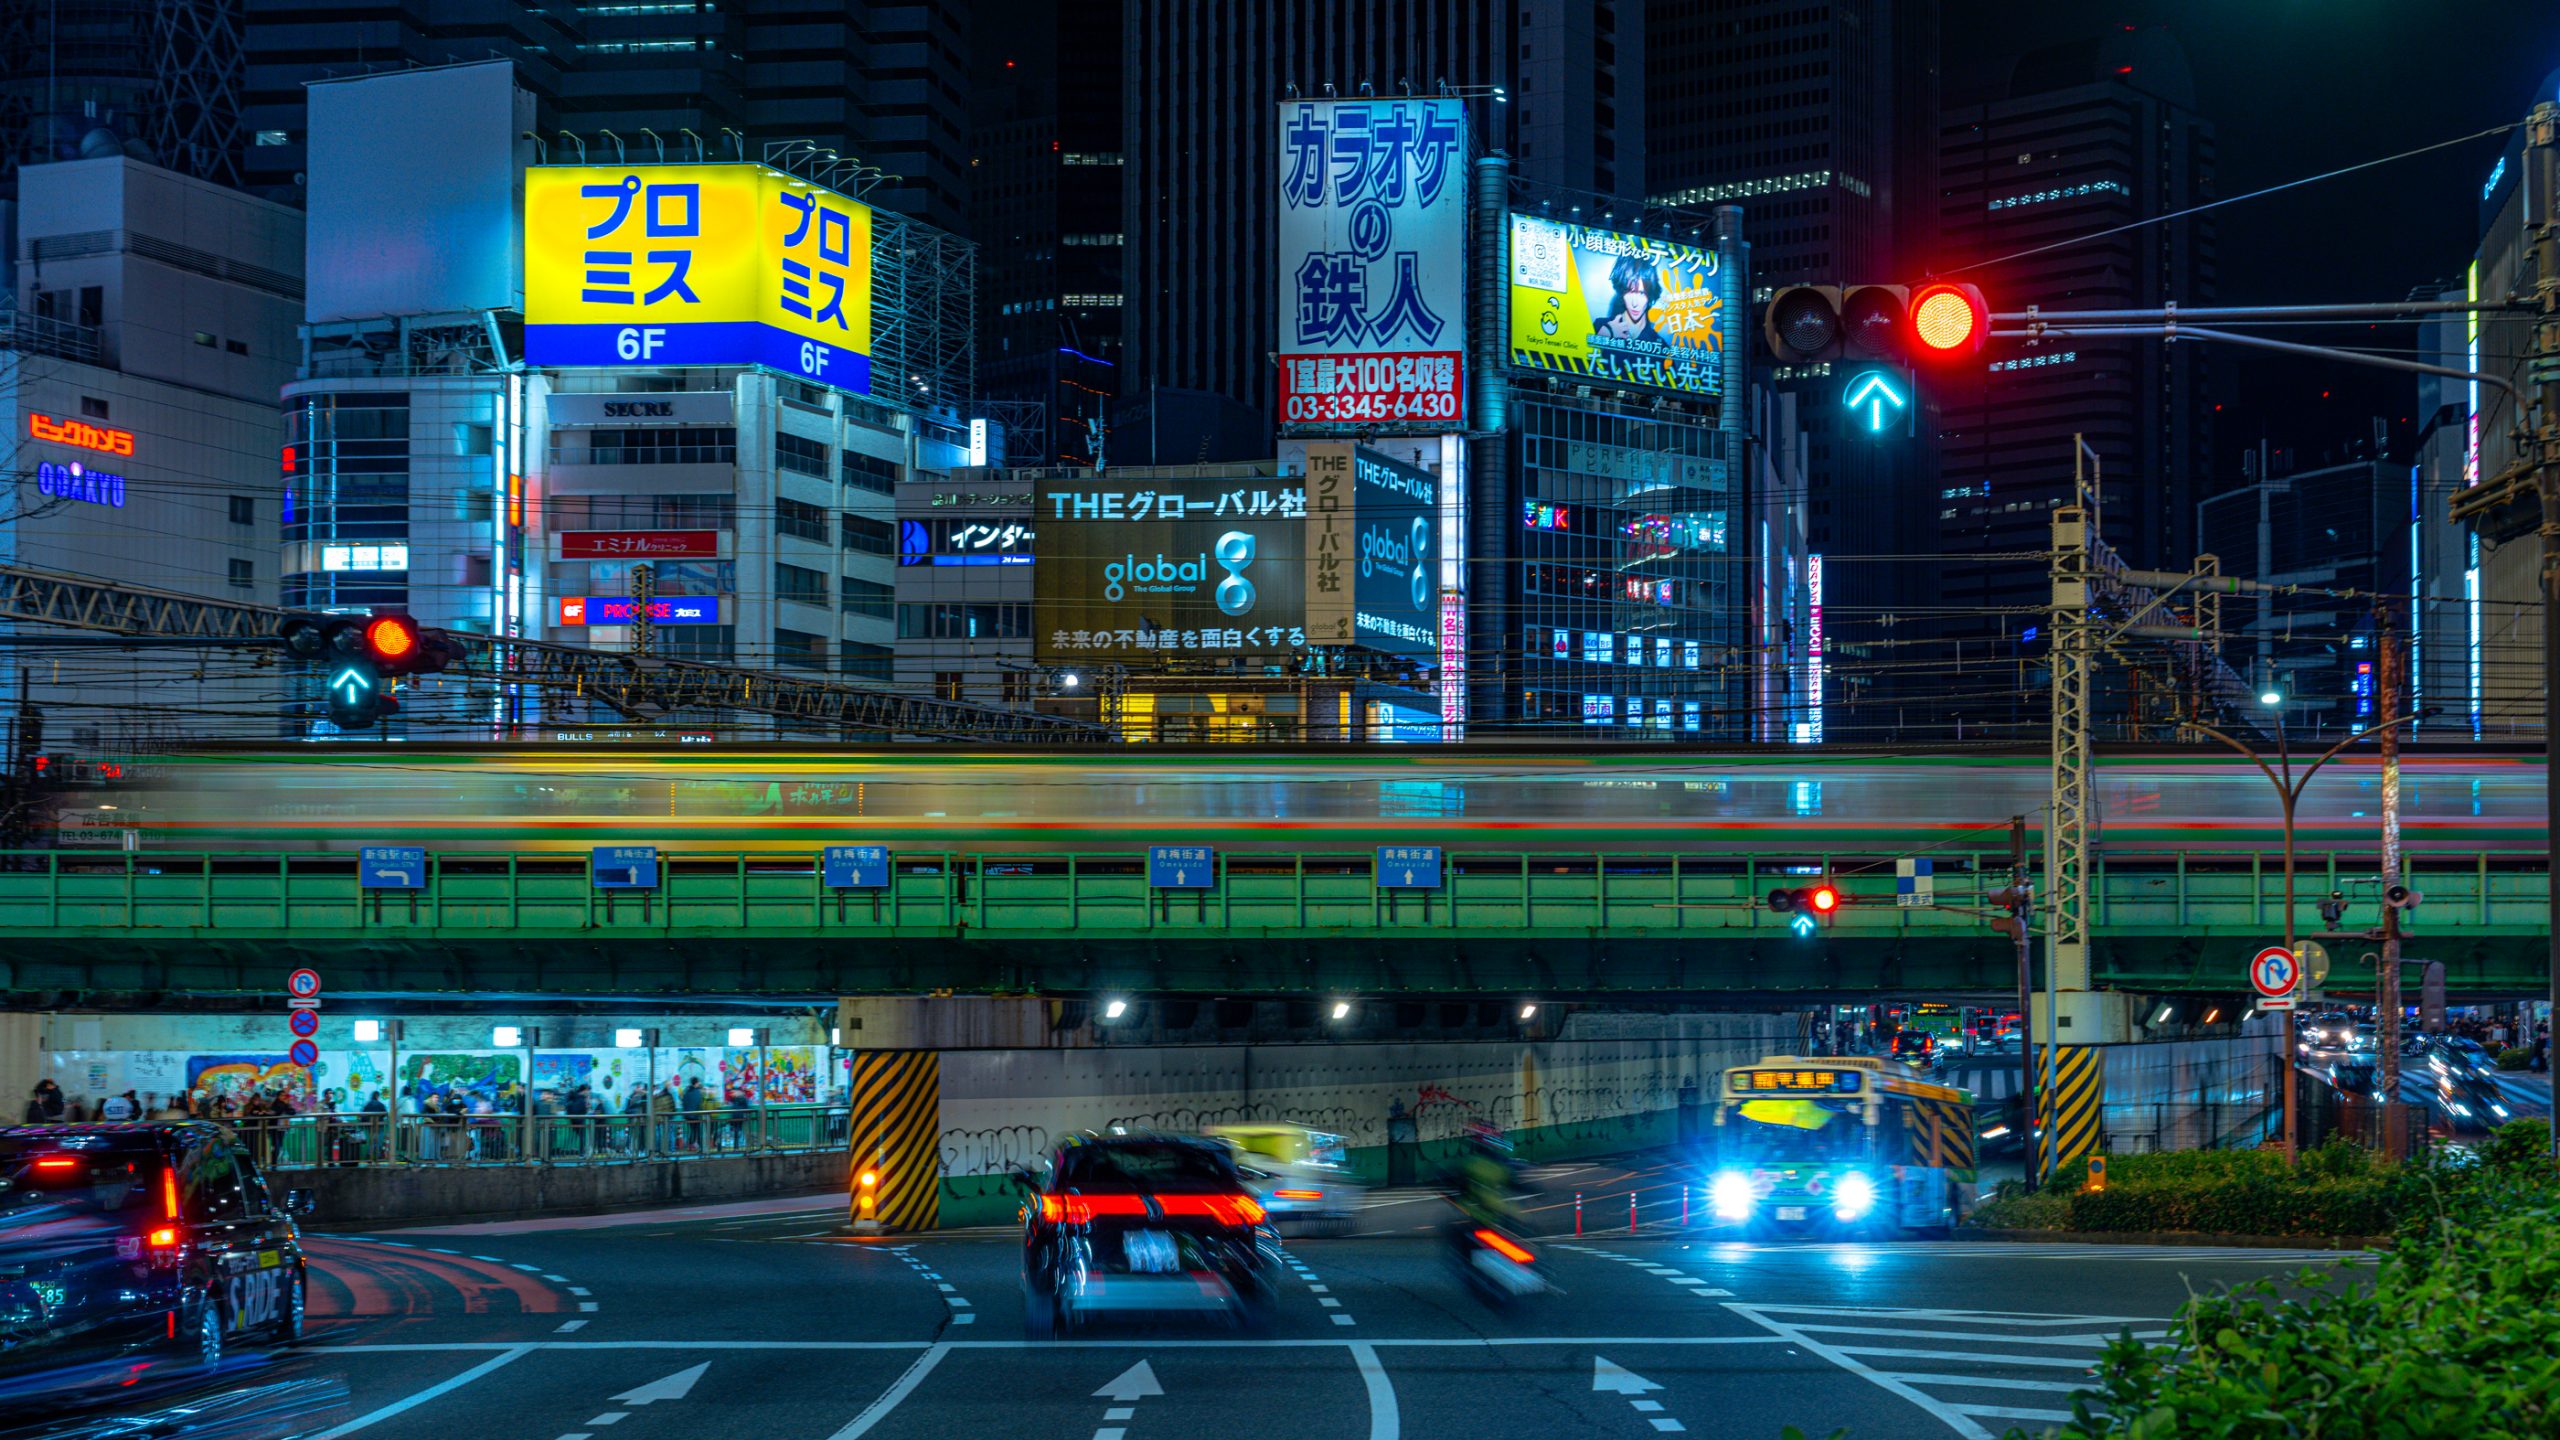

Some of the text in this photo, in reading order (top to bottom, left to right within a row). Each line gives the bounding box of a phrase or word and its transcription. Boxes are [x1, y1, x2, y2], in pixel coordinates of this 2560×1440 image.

[1284, 101, 1459, 210] カラオケ
[581, 175, 699, 239] プロ
[780, 191, 849, 267] プロ
[1350, 198, 1392, 262] の
[1568, 231, 1719, 278] 小顔整形ならテンクリ
[582, 250, 701, 306] ミス
[780, 258, 849, 331] ミス
[1295, 251, 1445, 348] 鉄人
[617, 328, 665, 359] 6F
[1667, 310, 1720, 334] 日本一
[800, 341, 830, 376] 6F
[1287, 356, 1455, 393] 1室最大100名収容
[1587, 348, 1721, 392] たいせい先生
[1287, 394, 1455, 420] 03-3345-6430
[30, 413, 135, 456] ビックカメラ
[38, 461, 126, 508] ODAKYU
[1357, 459, 1433, 504] THEグローバル社
[1048, 488, 1307, 520] THEグローバル社
[1310, 456, 1347, 592] THE グローバル社
[592, 537, 651, 553] エミナル
[1363, 524, 1408, 578] global
[1104, 553, 1206, 602] global
[557, 733, 592, 742] BULLS
[61, 830, 78, 841] TEL
[832, 849, 881, 860] 青梅街道
[1157, 849, 1205, 860] 青梅街道
[1385, 849, 1433, 860] 青梅街道
